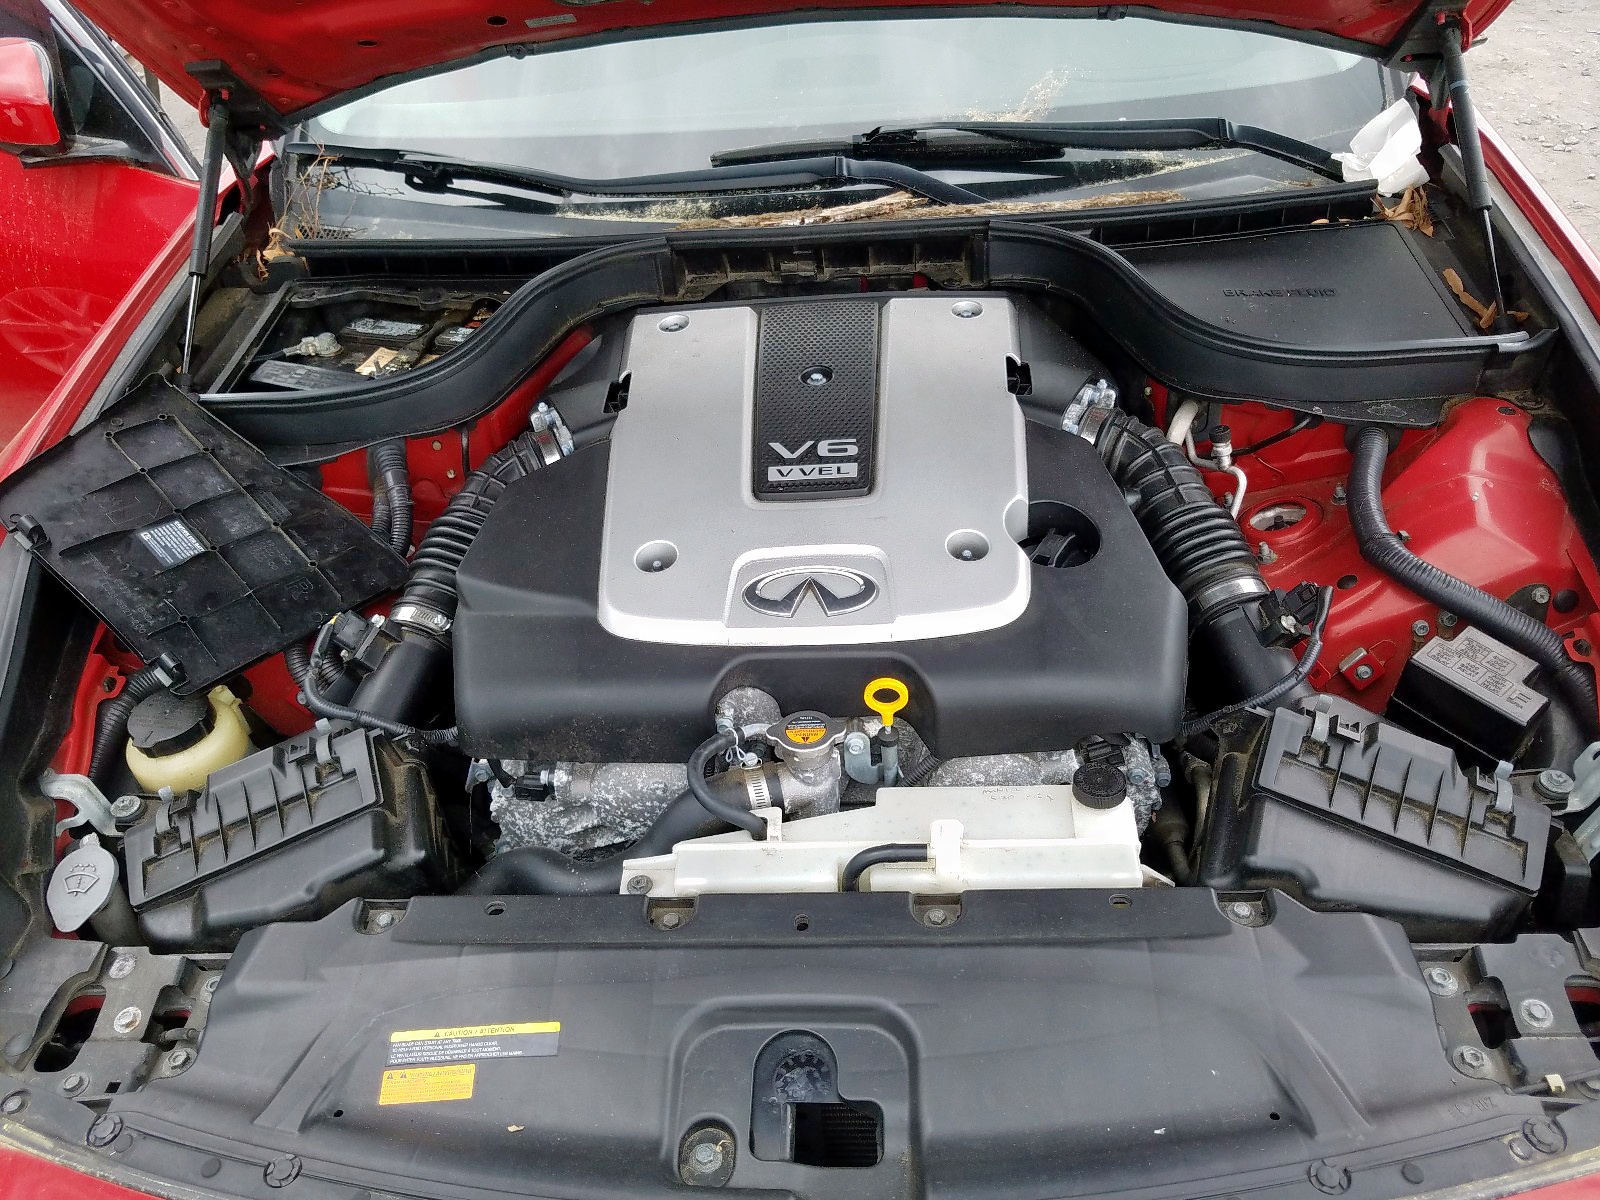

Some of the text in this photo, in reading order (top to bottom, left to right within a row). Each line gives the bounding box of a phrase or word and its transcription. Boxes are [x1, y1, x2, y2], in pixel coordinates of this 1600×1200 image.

[1223, 288, 1336, 297] BRAKE FLUID
[767, 438, 859, 459] V6
[776, 466, 850, 478] VVEL
[444, 1029, 473, 1037] CAUTION
[480, 1026, 515, 1035] ATTENTION
